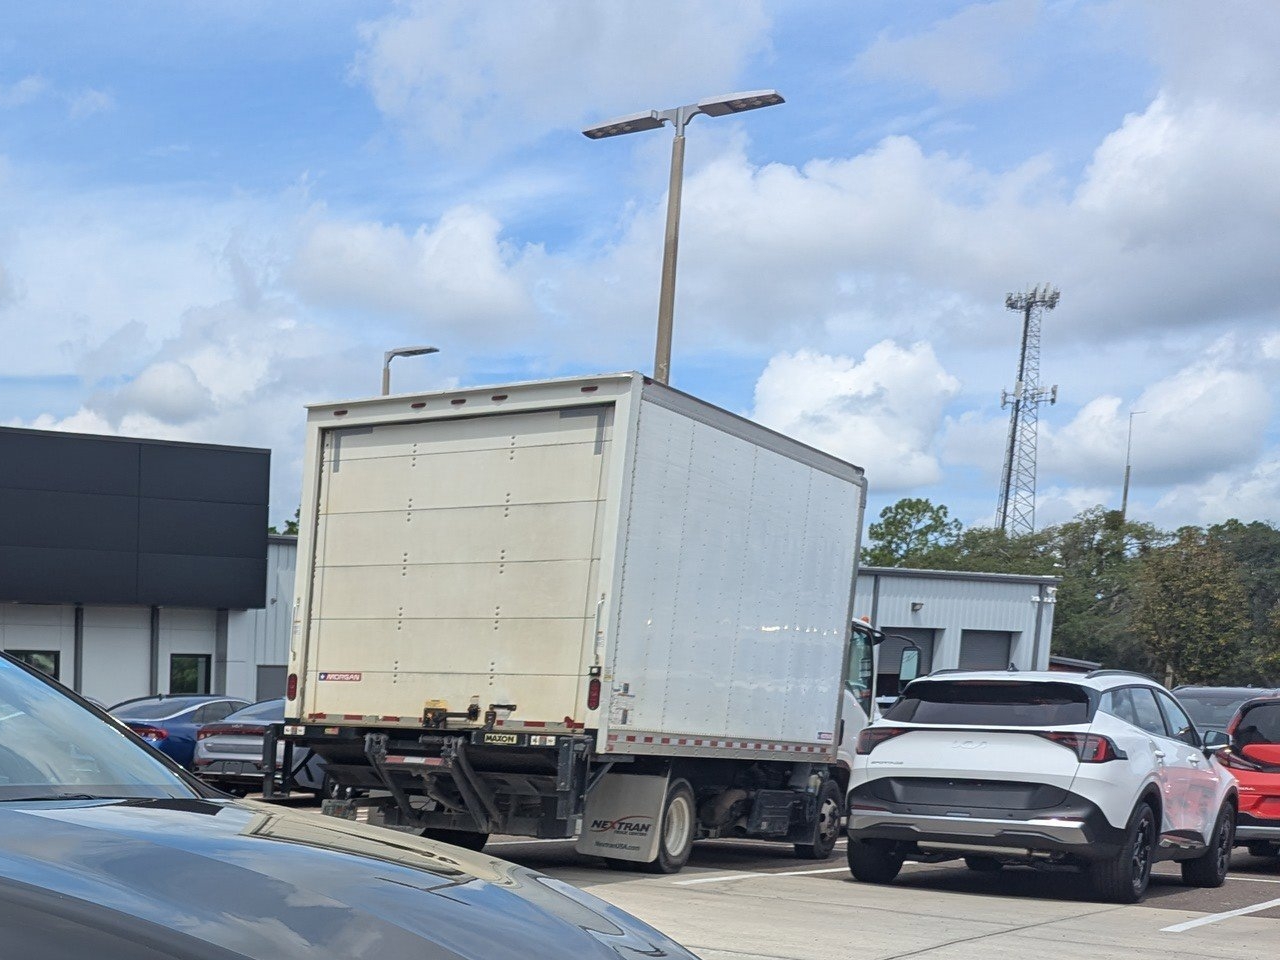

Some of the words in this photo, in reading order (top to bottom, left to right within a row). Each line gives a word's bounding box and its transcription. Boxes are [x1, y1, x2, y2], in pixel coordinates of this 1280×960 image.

[326, 673, 360, 681] MORGAN
[485, 734, 515, 743] MAXON
[591, 820, 651, 832] NEXTRAN
